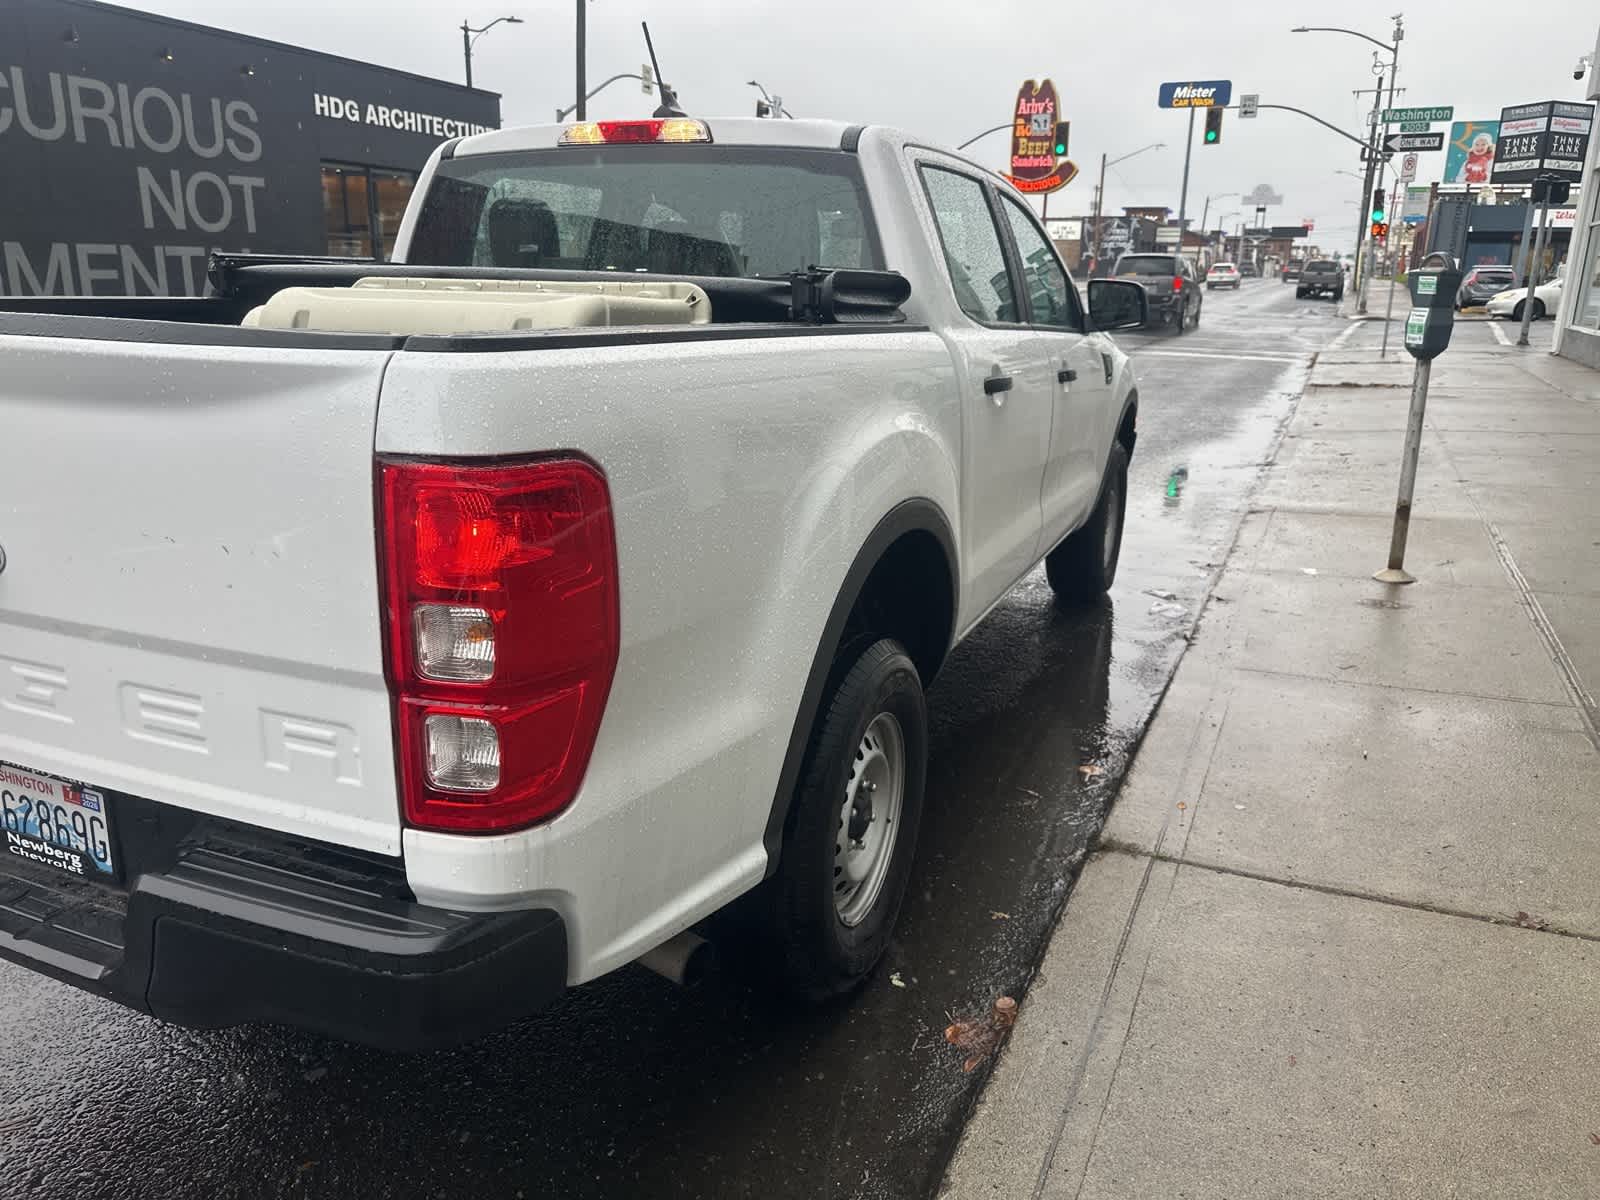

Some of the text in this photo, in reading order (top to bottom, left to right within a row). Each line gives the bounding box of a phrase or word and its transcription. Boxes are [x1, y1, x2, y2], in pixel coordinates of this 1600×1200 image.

[1173, 84, 1217, 98] Mister
[1018, 98, 1054, 114] Arby's
[1172, 98, 1215, 107] CAR WASH
[0, 66, 262, 162] URIOUS
[314, 93, 497, 138] HDG ARCHITECTUR
[1384, 109, 1450, 121] Washington
[1018, 138, 1050, 155] BEEF
[1401, 137, 1437, 147] ONE WAY
[1504, 144, 1537, 154] TANK
[1552, 143, 1579, 153] TANK
[1012, 155, 1054, 167] Sandwich
[137, 166, 264, 233] NOT
[0, 241, 250, 297] MENT
[0, 789, 108, 862] 67869G
[7, 831, 82, 867] Newberg
[9, 845, 85, 875] Chevrolet
